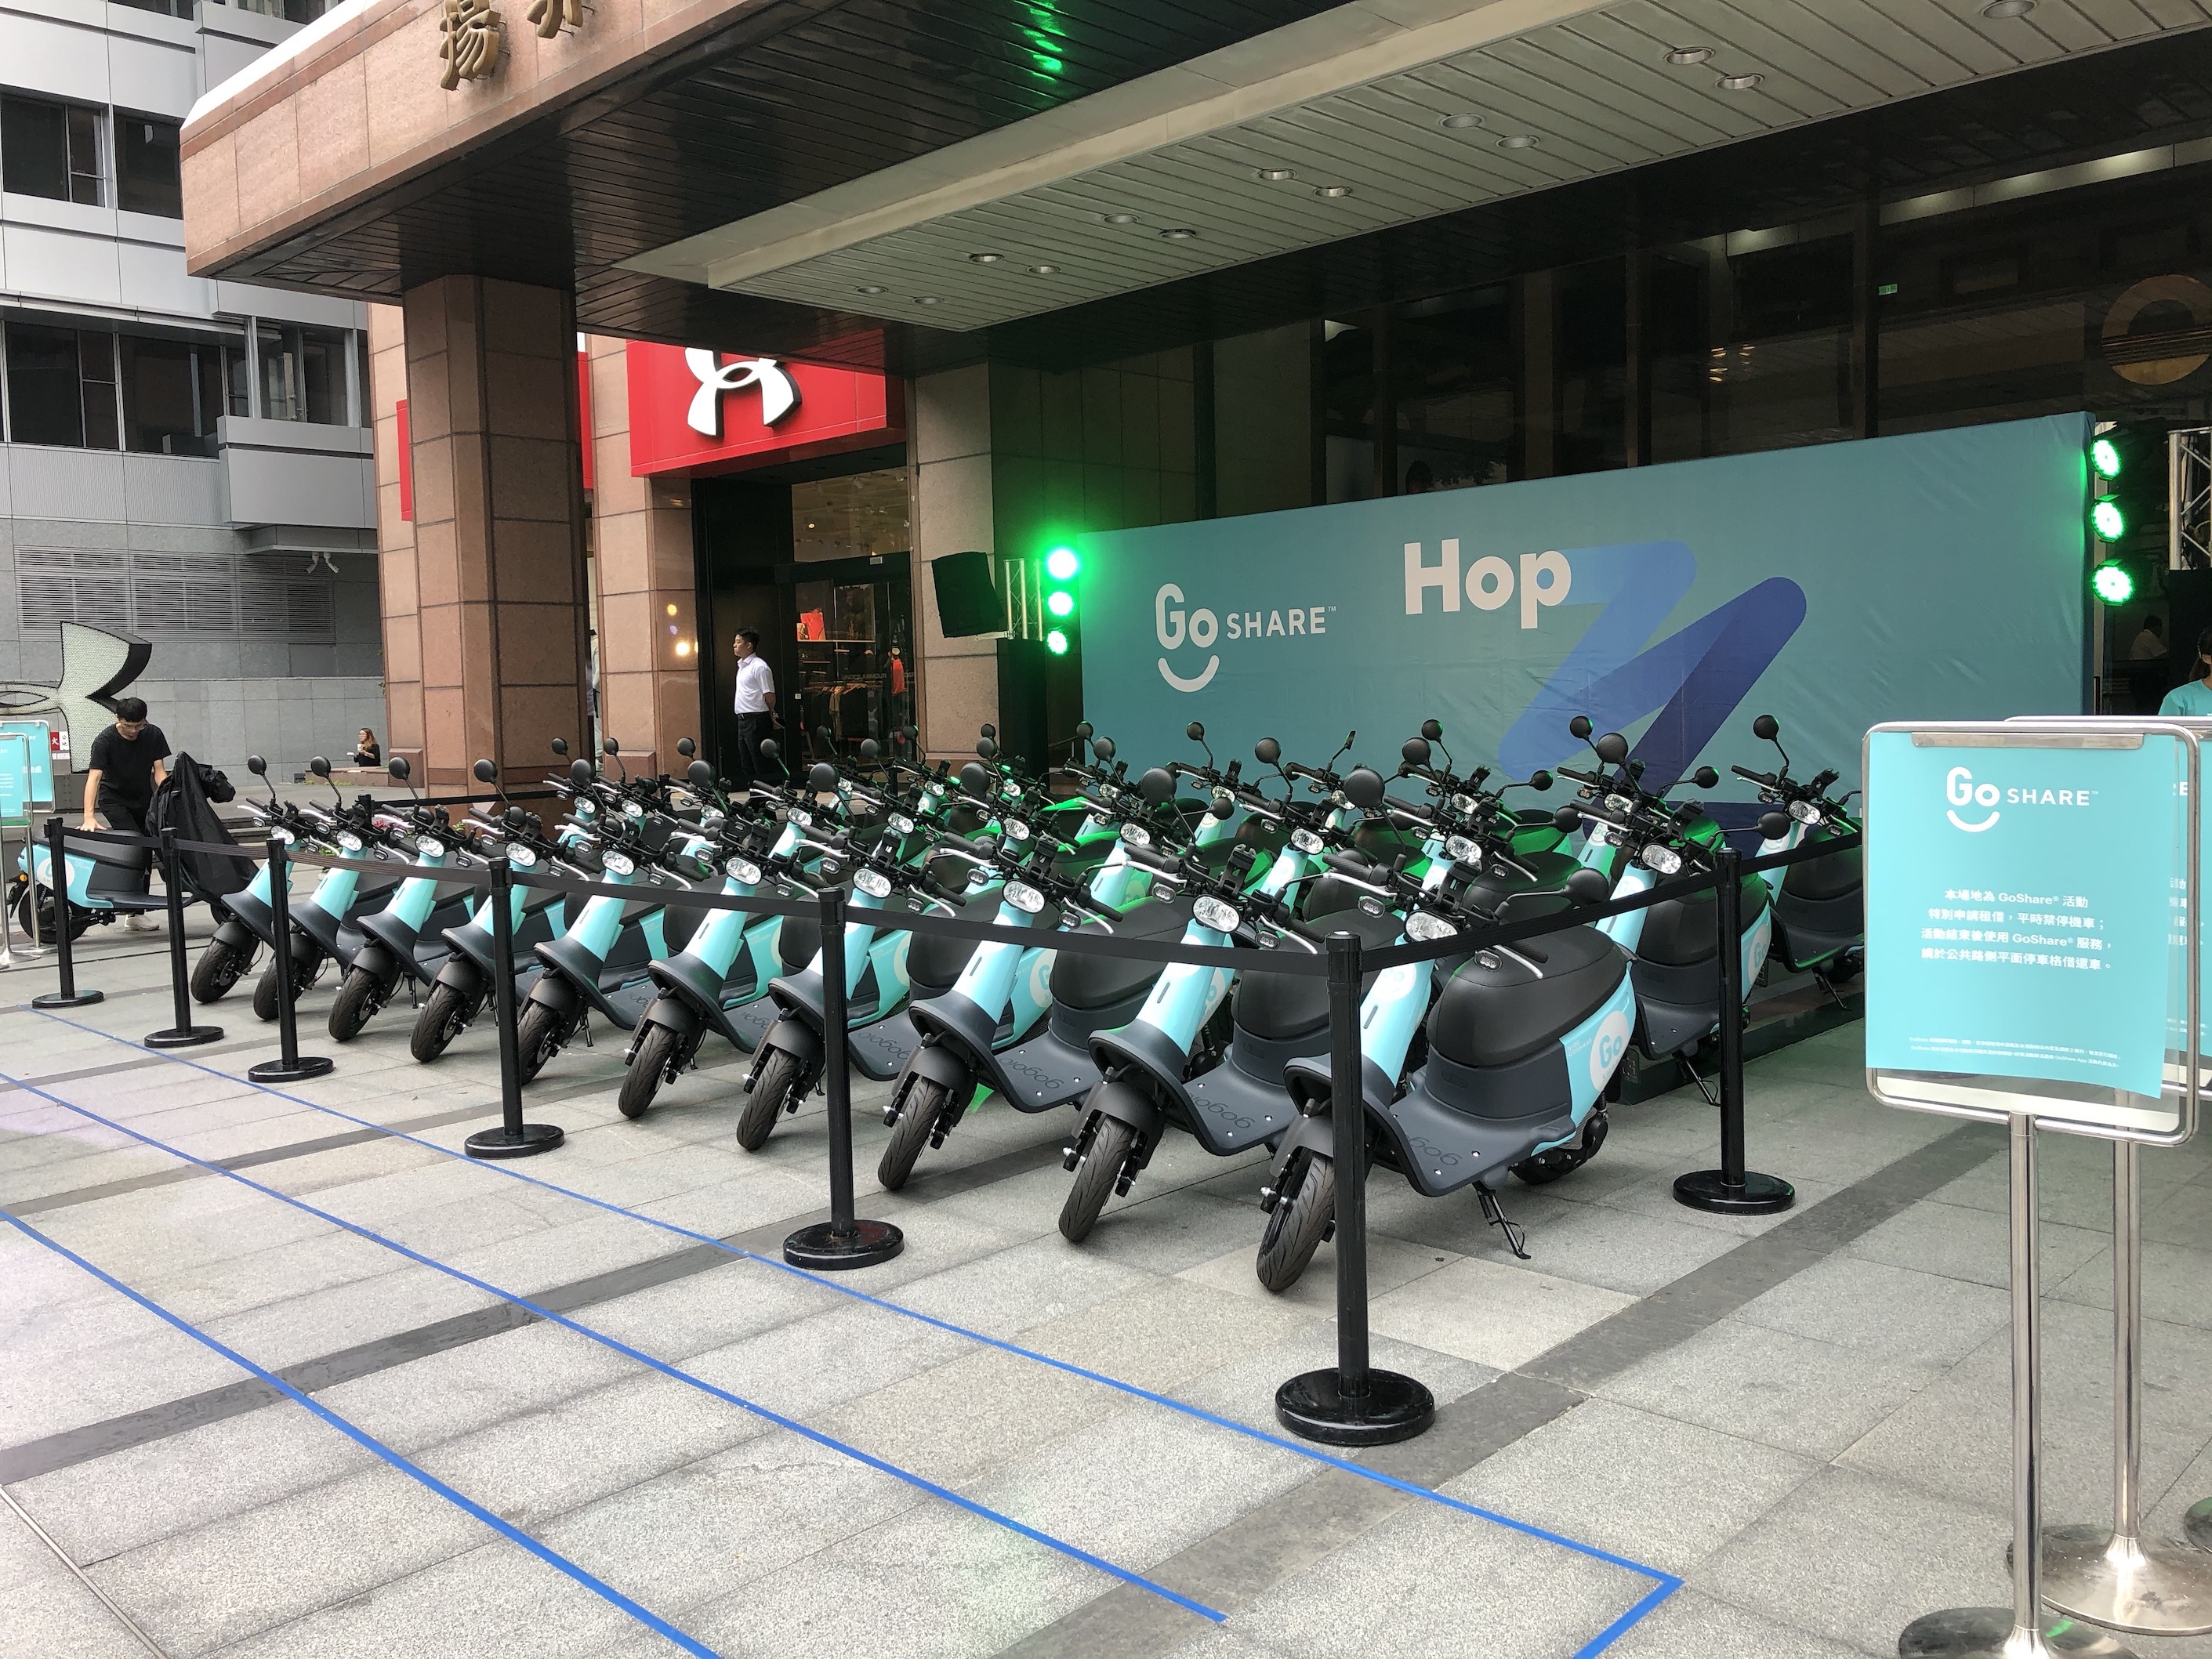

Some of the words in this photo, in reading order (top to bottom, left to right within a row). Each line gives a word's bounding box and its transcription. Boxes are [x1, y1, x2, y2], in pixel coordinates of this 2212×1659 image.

[1404, 538, 1572, 629] Hop
[1155, 583, 1220, 650] Go
[1946, 766, 2000, 807] Go
[1944, 889, 1995, 903] 本場地為
[2062, 894, 2089, 909] 活動
[1599, 1034, 1623, 1069] Go
[999, 1057, 1065, 1089] gogoro
